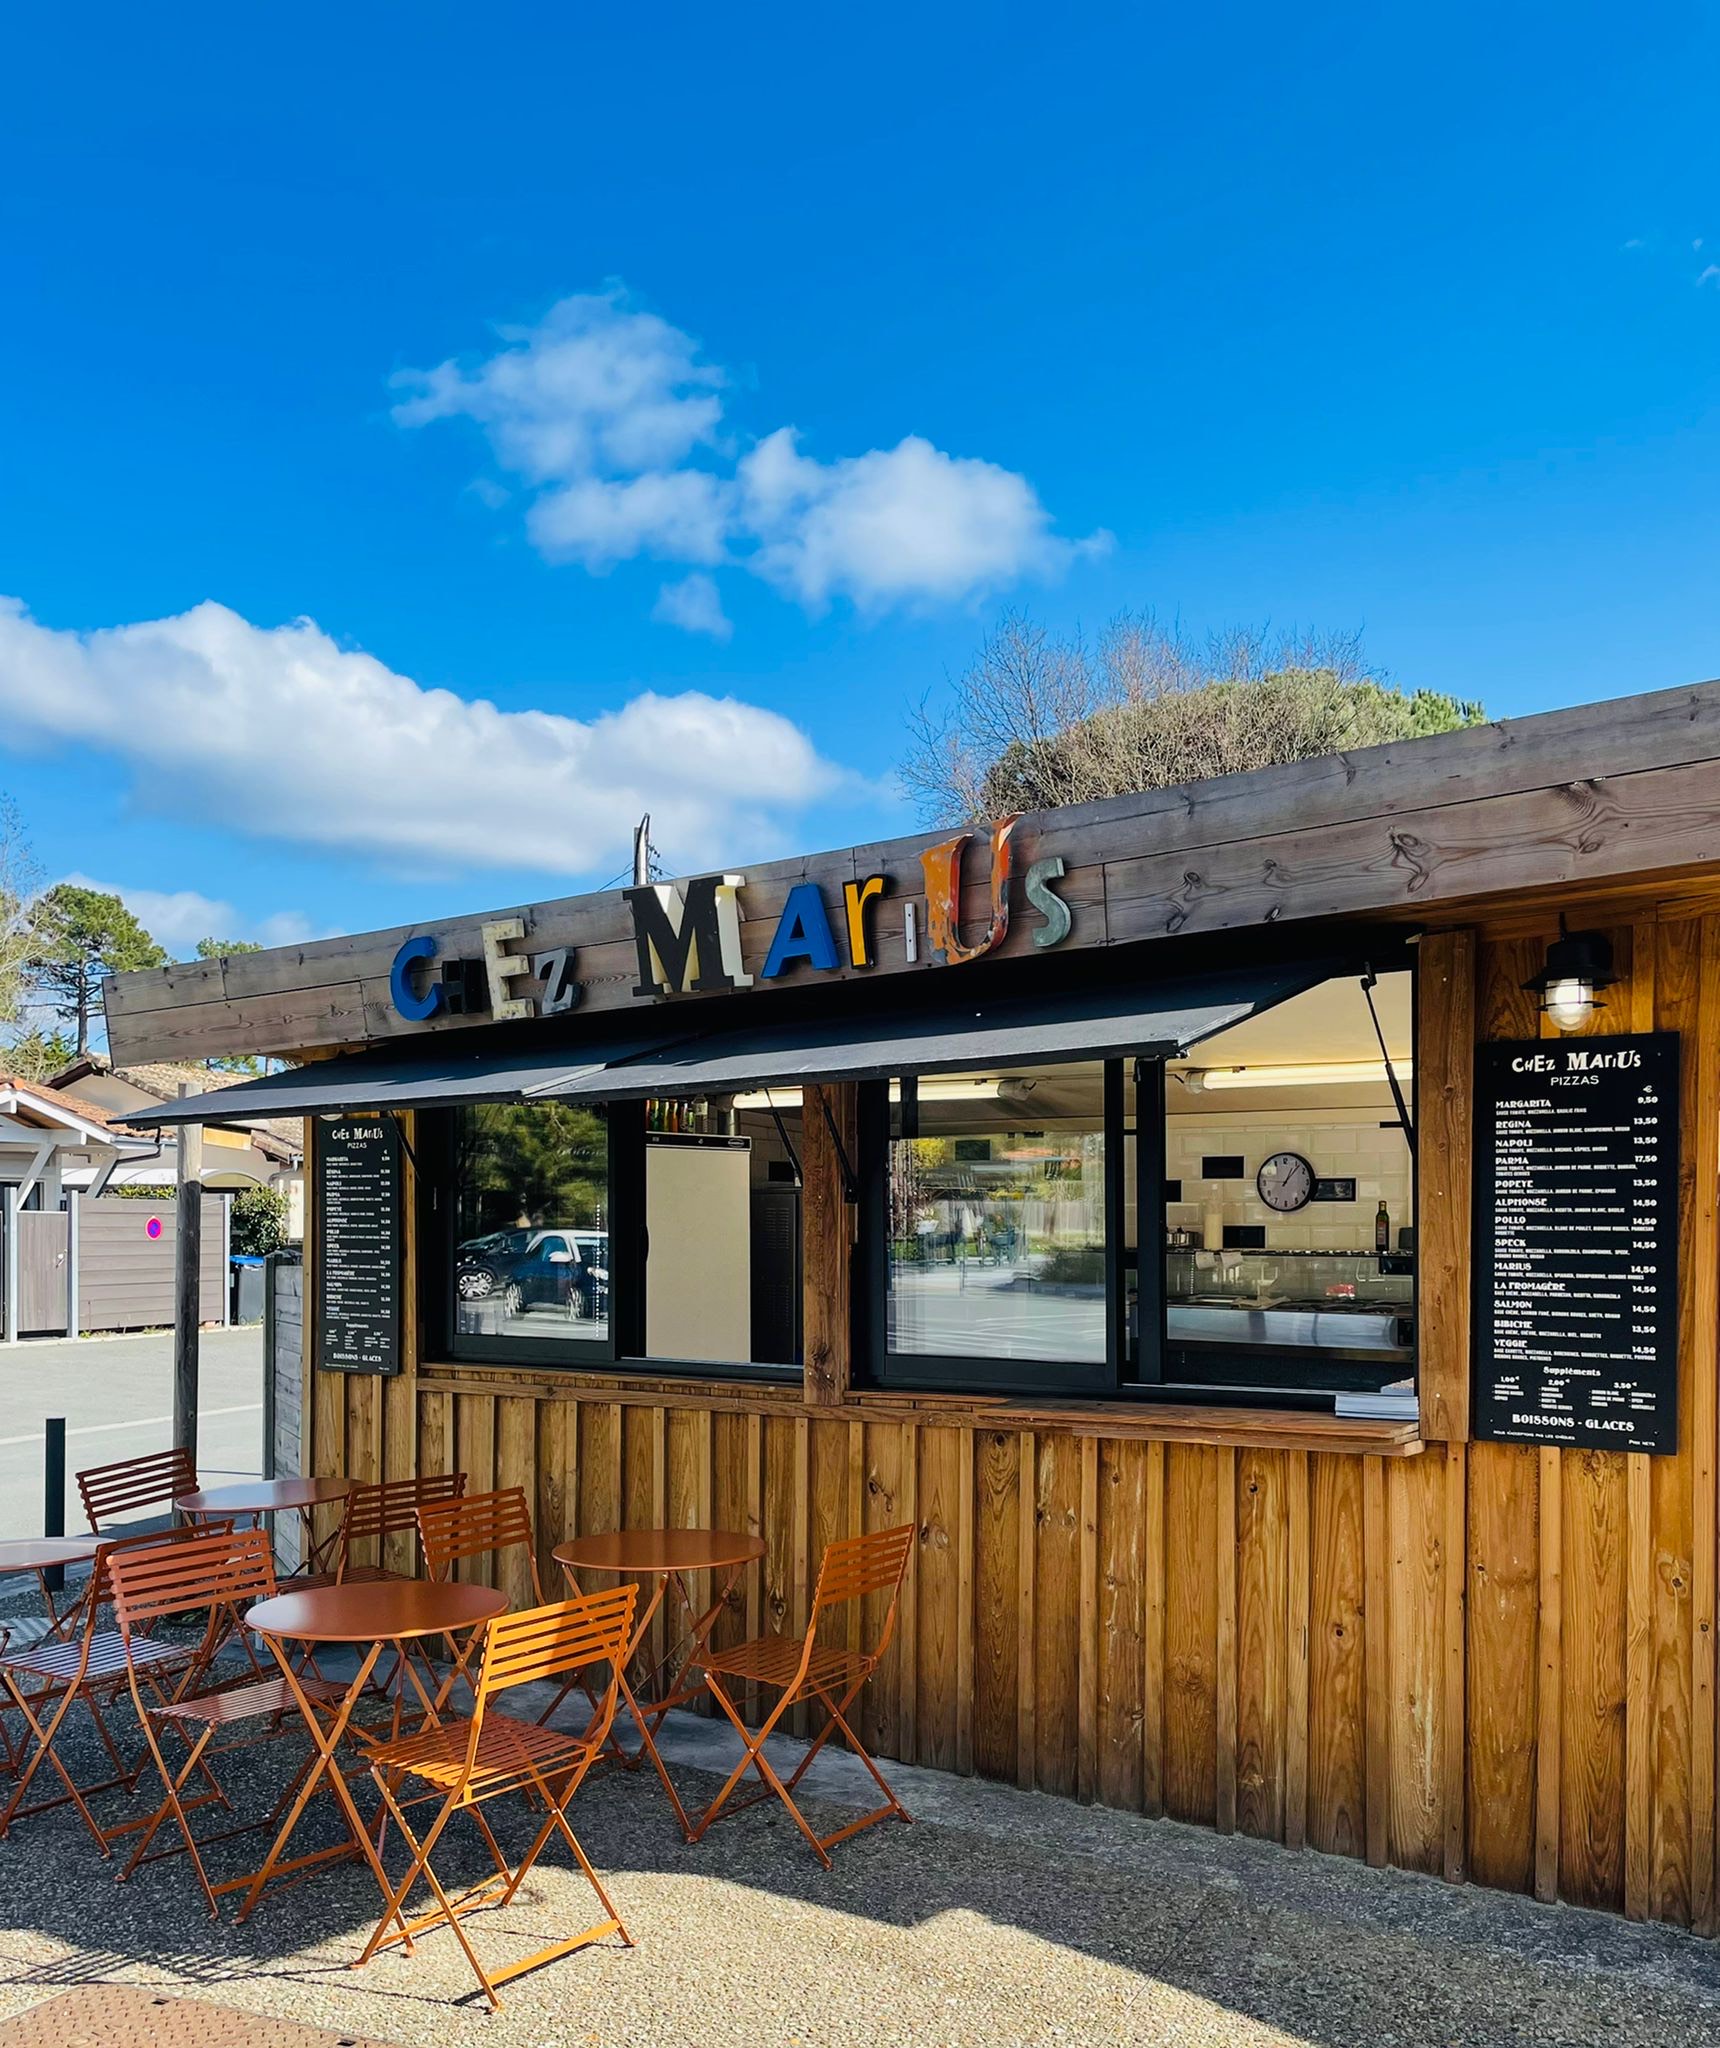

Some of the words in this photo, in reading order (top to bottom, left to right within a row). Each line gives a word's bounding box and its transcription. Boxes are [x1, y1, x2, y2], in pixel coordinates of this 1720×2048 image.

[1550, 1075, 1600, 1086] PIZZAS
[1496, 1099, 1551, 1108] MARGARITA
[1634, 1117, 1658, 1125] 13,50
[1495, 1139, 1533, 1147] NAPOLI
[1495, 1180, 1533, 1188] POPEYE
[1633, 1179, 1657, 1187] 13,50
[1495, 1216, 1526, 1224] POLLO
[1494, 1239, 1526, 1247] SPECK
[1632, 1241, 1657, 1249] 14,50
[1509, 1281, 1565, 1291] FROMAGÈRE
[1494, 1320, 1532, 1328] BIBICHE
[1632, 1325, 1656, 1333] 13,50
[1494, 1339, 1527, 1347] VEGGIE
[1543, 1366, 1601, 1376] Suppléments
[1512, 1414, 1575, 1427] BOISSONS
[1585, 1419, 1635, 1432] GLACES
